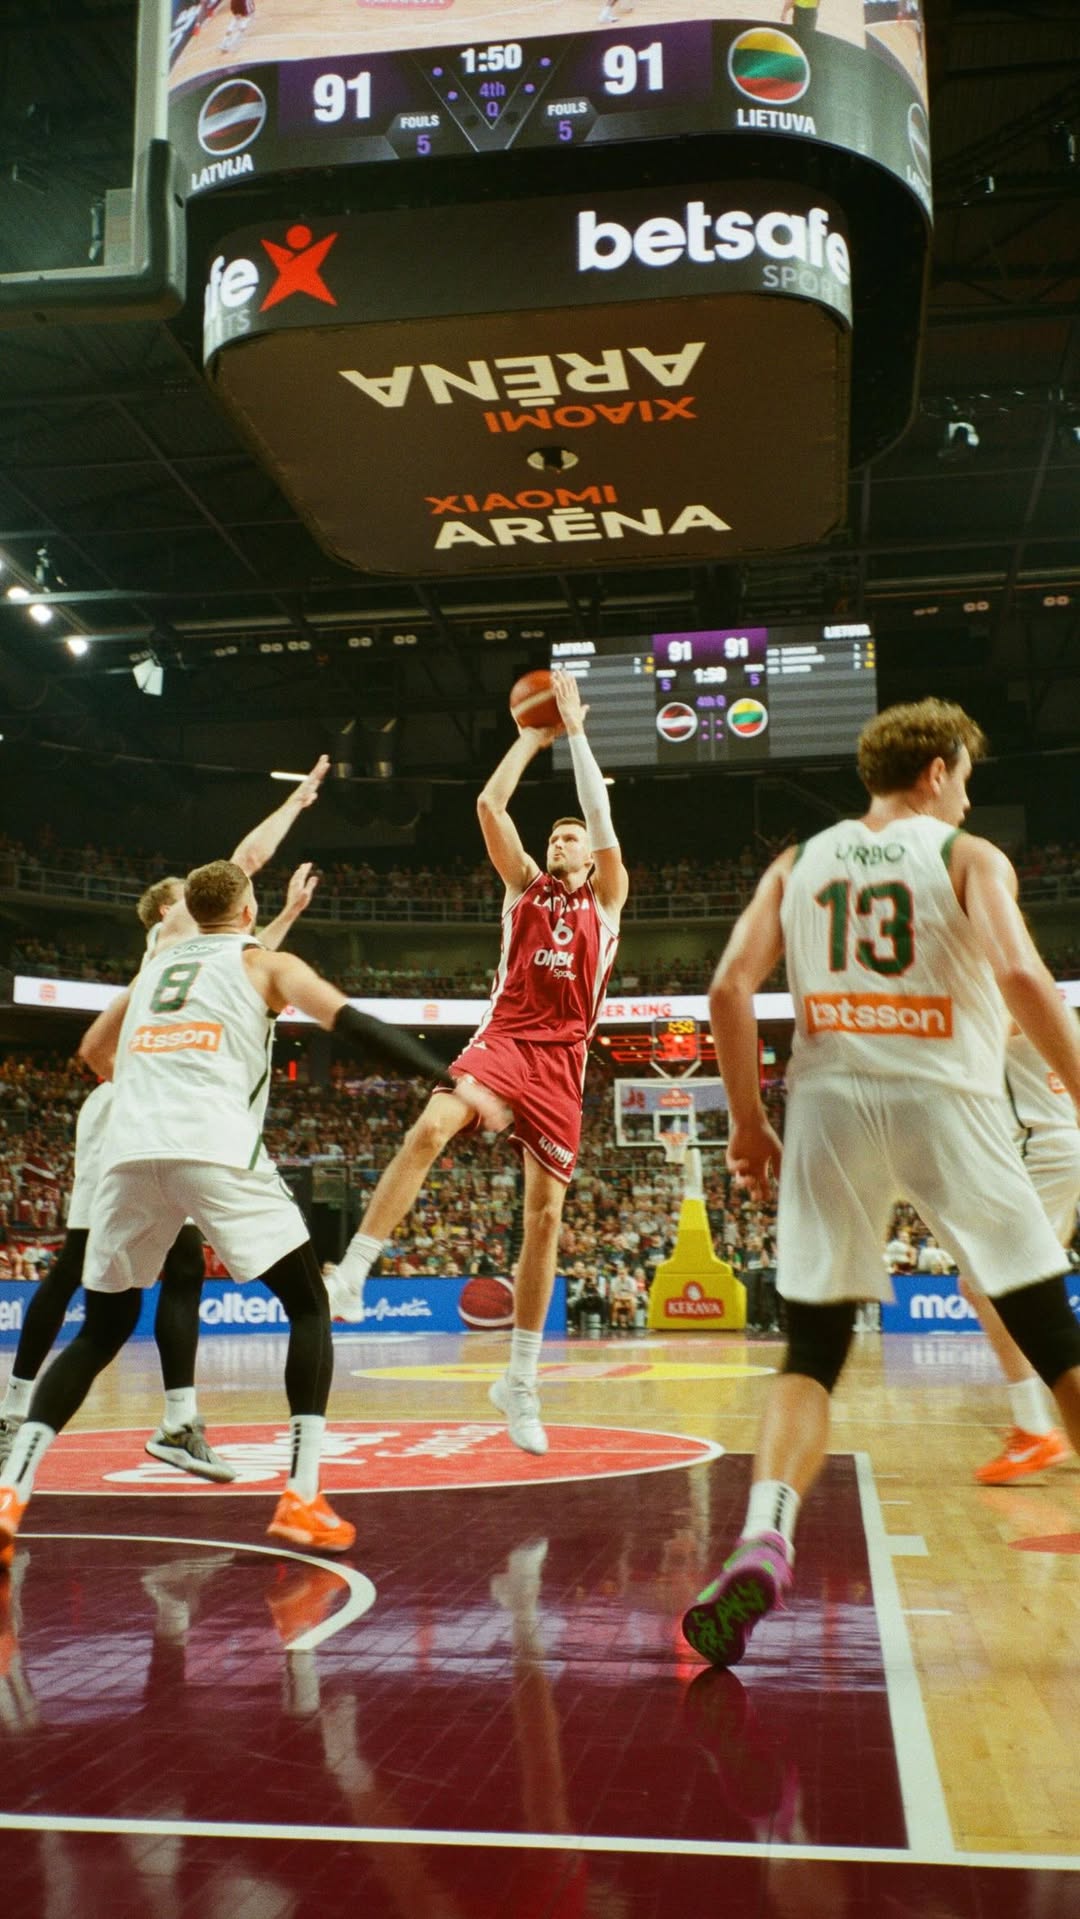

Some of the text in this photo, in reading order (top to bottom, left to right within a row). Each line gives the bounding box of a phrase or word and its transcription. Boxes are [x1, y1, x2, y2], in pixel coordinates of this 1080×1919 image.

[461, 44, 522, 73] 1:50
[603, 42, 663, 94] 91
[313, 72, 371, 123] 91
[480, 82, 506, 99] 4th
[400, 115, 440, 129] FOULS
[547, 102, 587, 116] FOULS
[737, 108, 817, 135] LIETUVA
[417, 135, 431, 154] 5
[559, 121, 573, 141] 5
[191, 154, 254, 190] LATVIJA
[578, 201, 850, 286] betsafe
[338, 342, 706, 408] ARĒNA
[484, 396, 698, 433] XIAOMI
[424, 485, 617, 515] XIAOMI
[434, 505, 732, 549] ARĒNA
[668, 641, 692, 662] 91
[725, 637, 749, 659] 91
[552, 918, 574, 946] 6
[815, 879, 915, 978] 13
[149, 961, 202, 1014] 8
[602, 1004, 625, 1017] ER
[199, 1293, 288, 1324] olten
